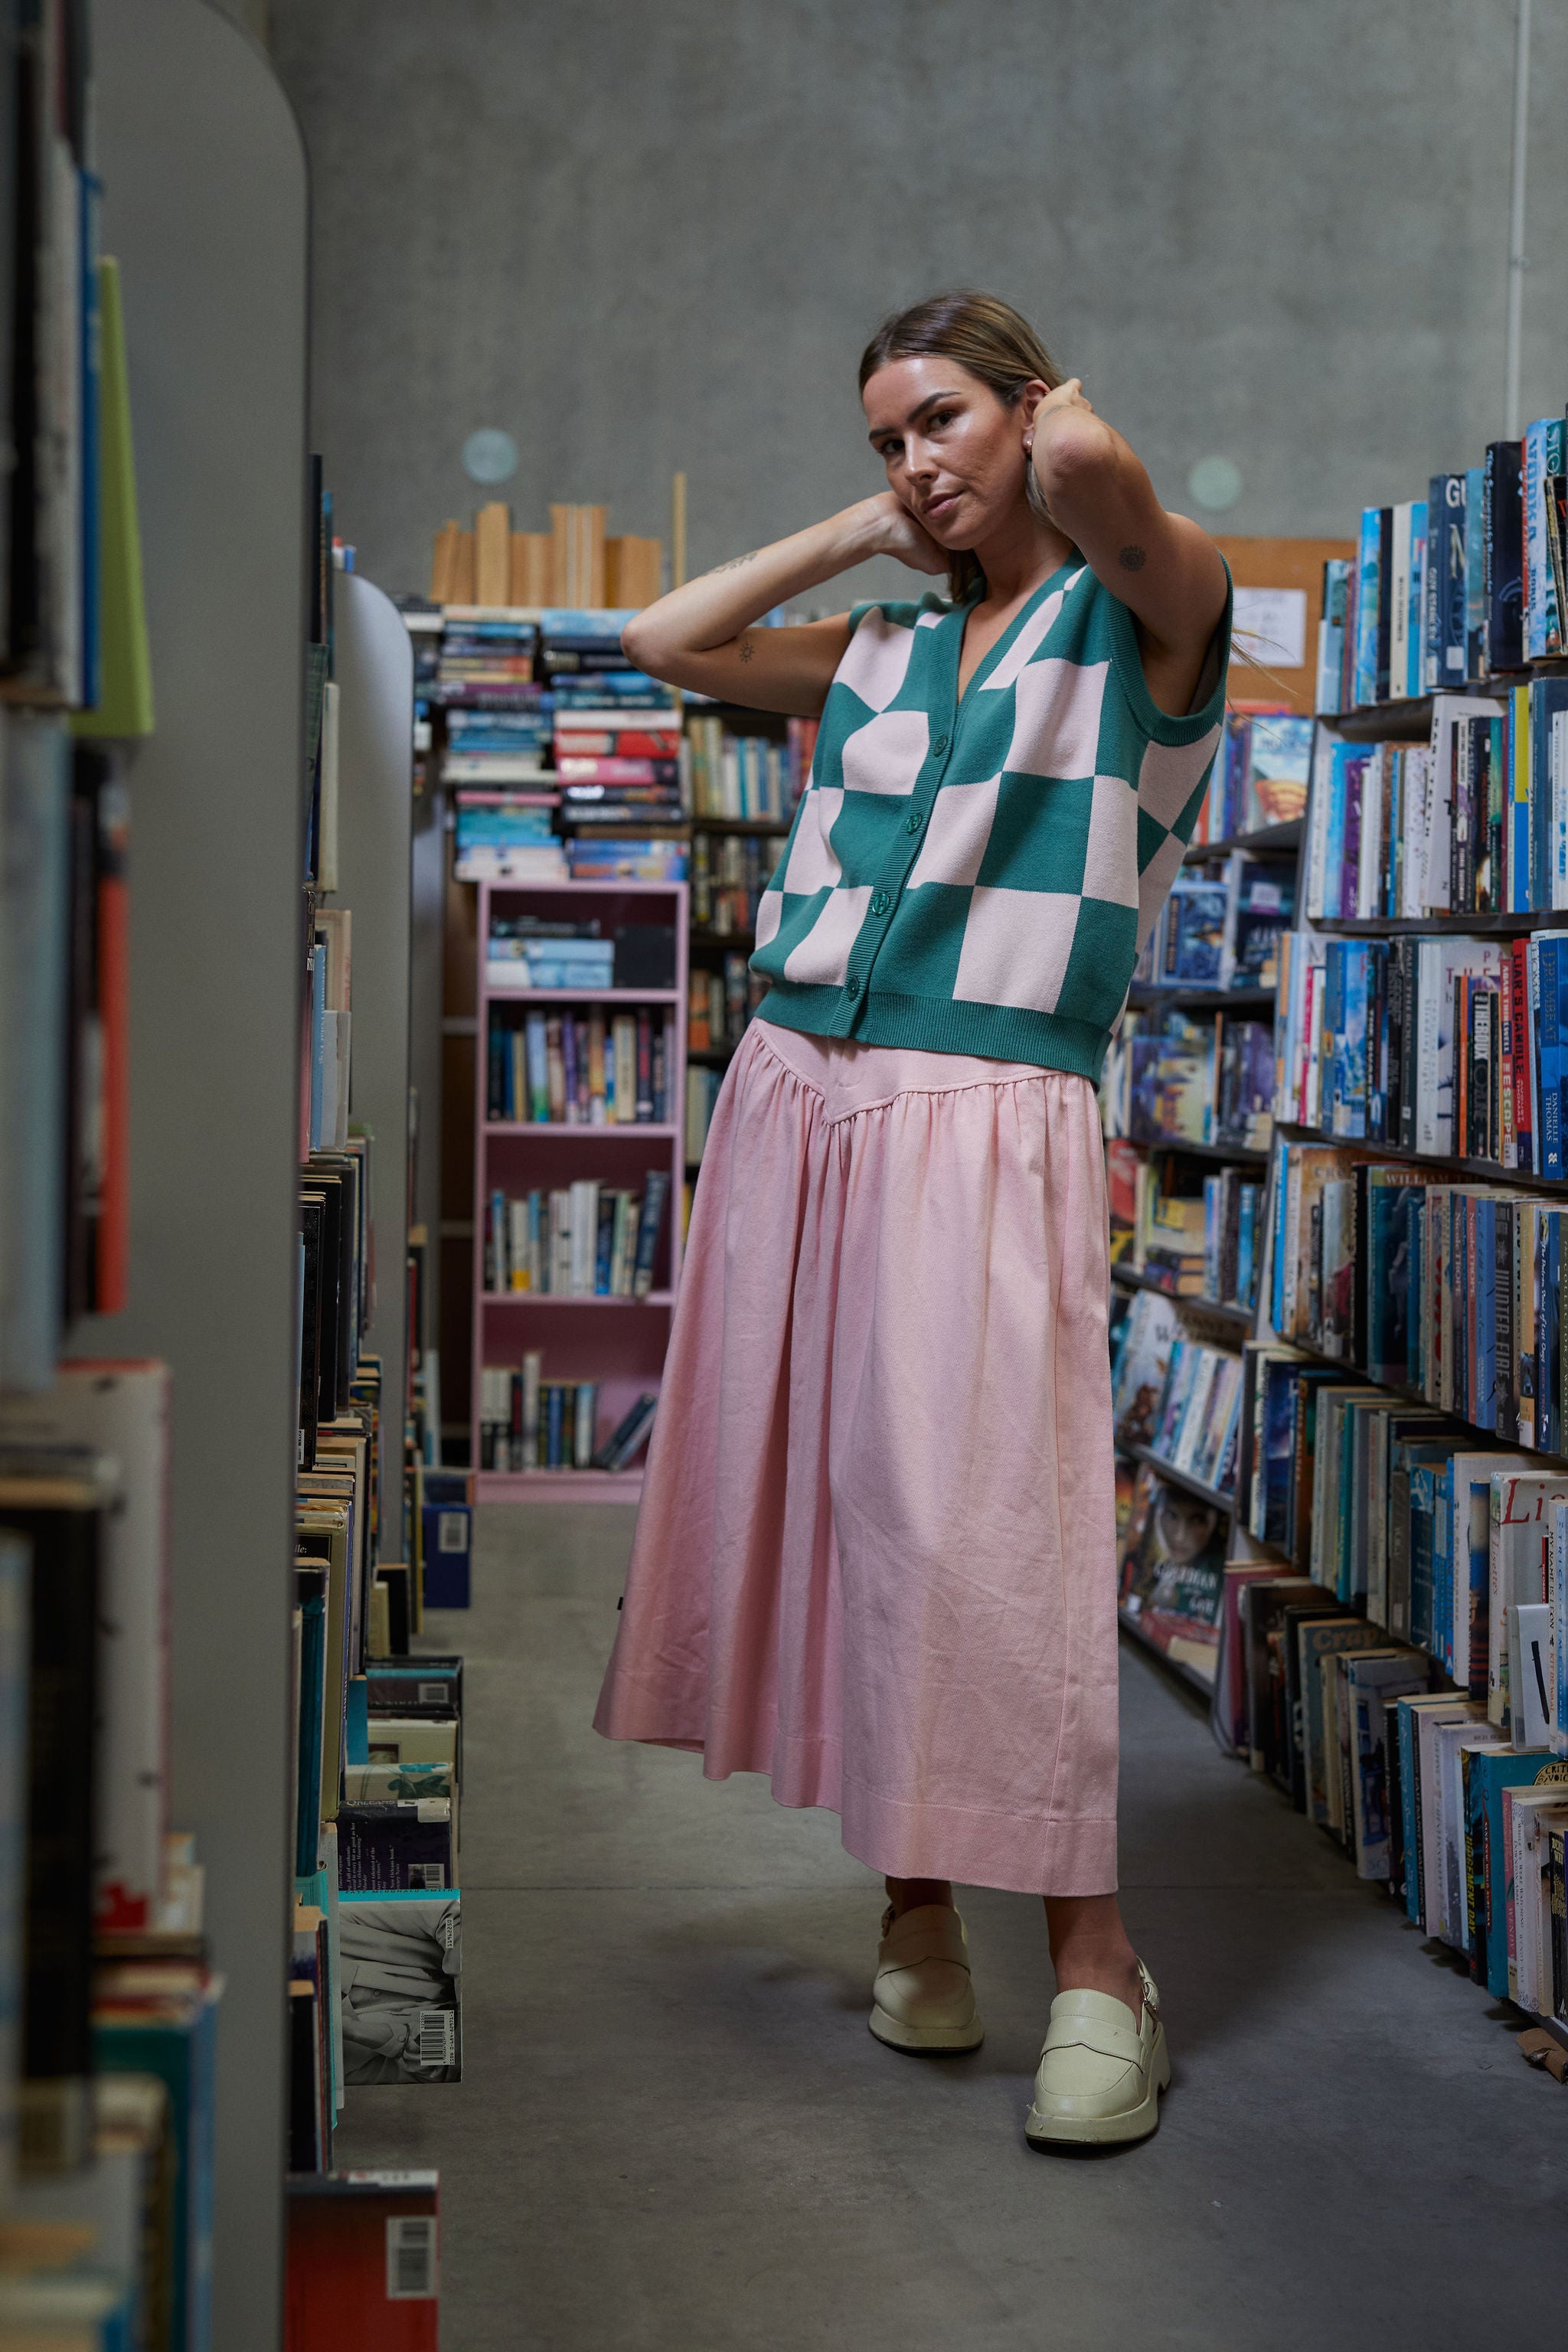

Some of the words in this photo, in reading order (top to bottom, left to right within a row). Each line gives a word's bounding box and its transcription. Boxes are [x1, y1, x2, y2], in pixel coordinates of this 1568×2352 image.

[1527, 438, 1537, 543] VODKA
[1405, 946, 1413, 978] PAUL
[1513, 954, 1523, 1005] LIAR'S
[1541, 952, 1557, 1042] DRUMBEAT
[1474, 1004, 1488, 1060] THEROUX
[1514, 1012, 1524, 1074] CANDLE
[1503, 1074, 1512, 1145] ESCAPE
[1385, 1173, 1446, 1185] WILLIAM
[1540, 1314, 1547, 1325] of
[1500, 1478, 1566, 1525] Li
[1549, 1531, 1554, 1547] MY
[1549, 1586, 1554, 1595] IS
[1550, 1672, 1555, 1684] DE
[1518, 1850, 1523, 1860] WE
[1468, 1909, 1476, 1935] DAY
